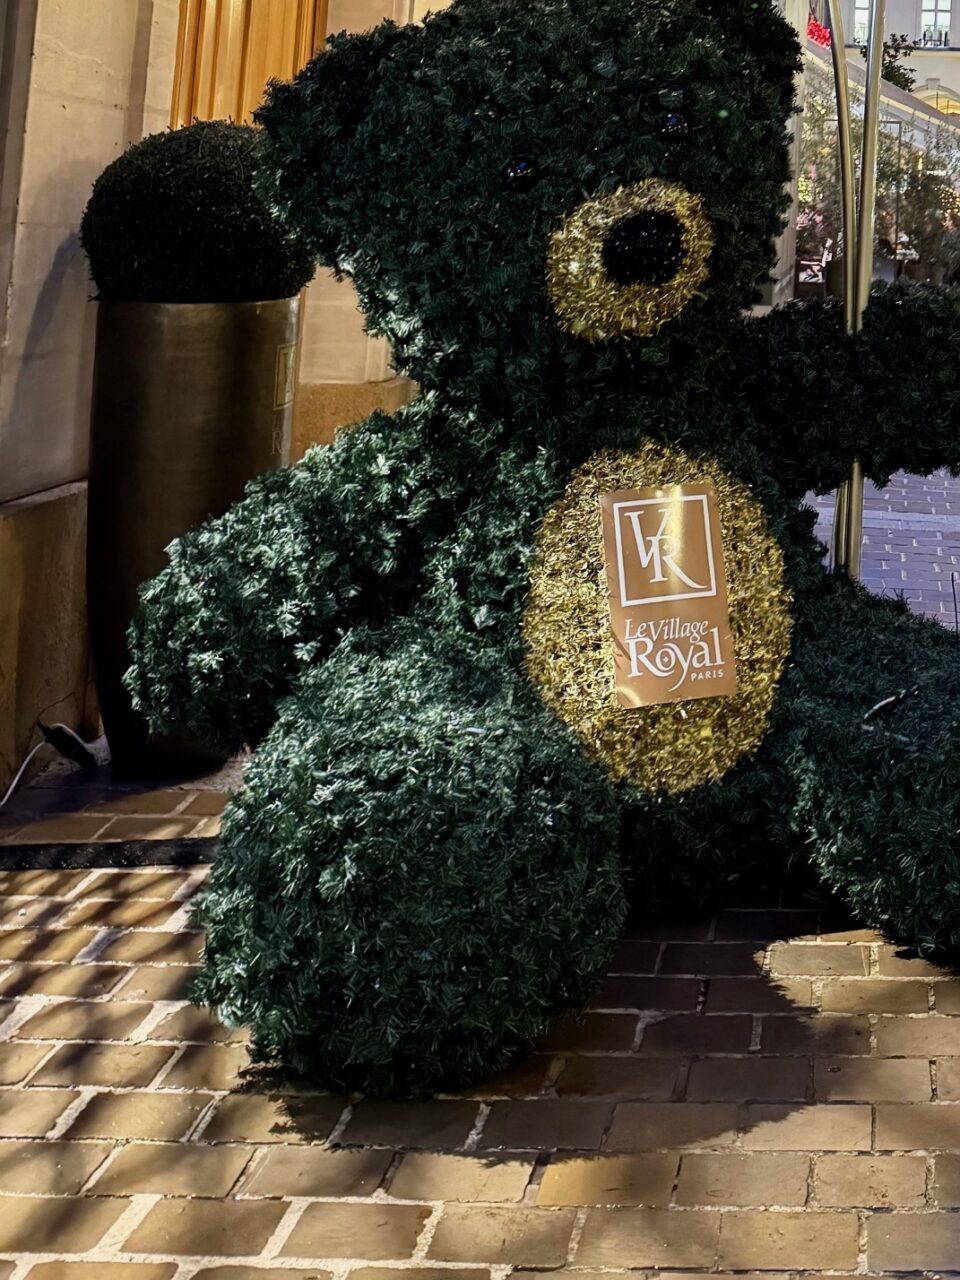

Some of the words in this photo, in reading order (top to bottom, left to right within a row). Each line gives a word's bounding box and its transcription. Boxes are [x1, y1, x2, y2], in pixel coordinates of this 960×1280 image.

[624, 508, 708, 589] VR
[624, 618, 647, 641] Le
[648, 617, 709, 644] Village
[625, 627, 725, 692] Royal
[691, 669, 725, 681] PARIS
